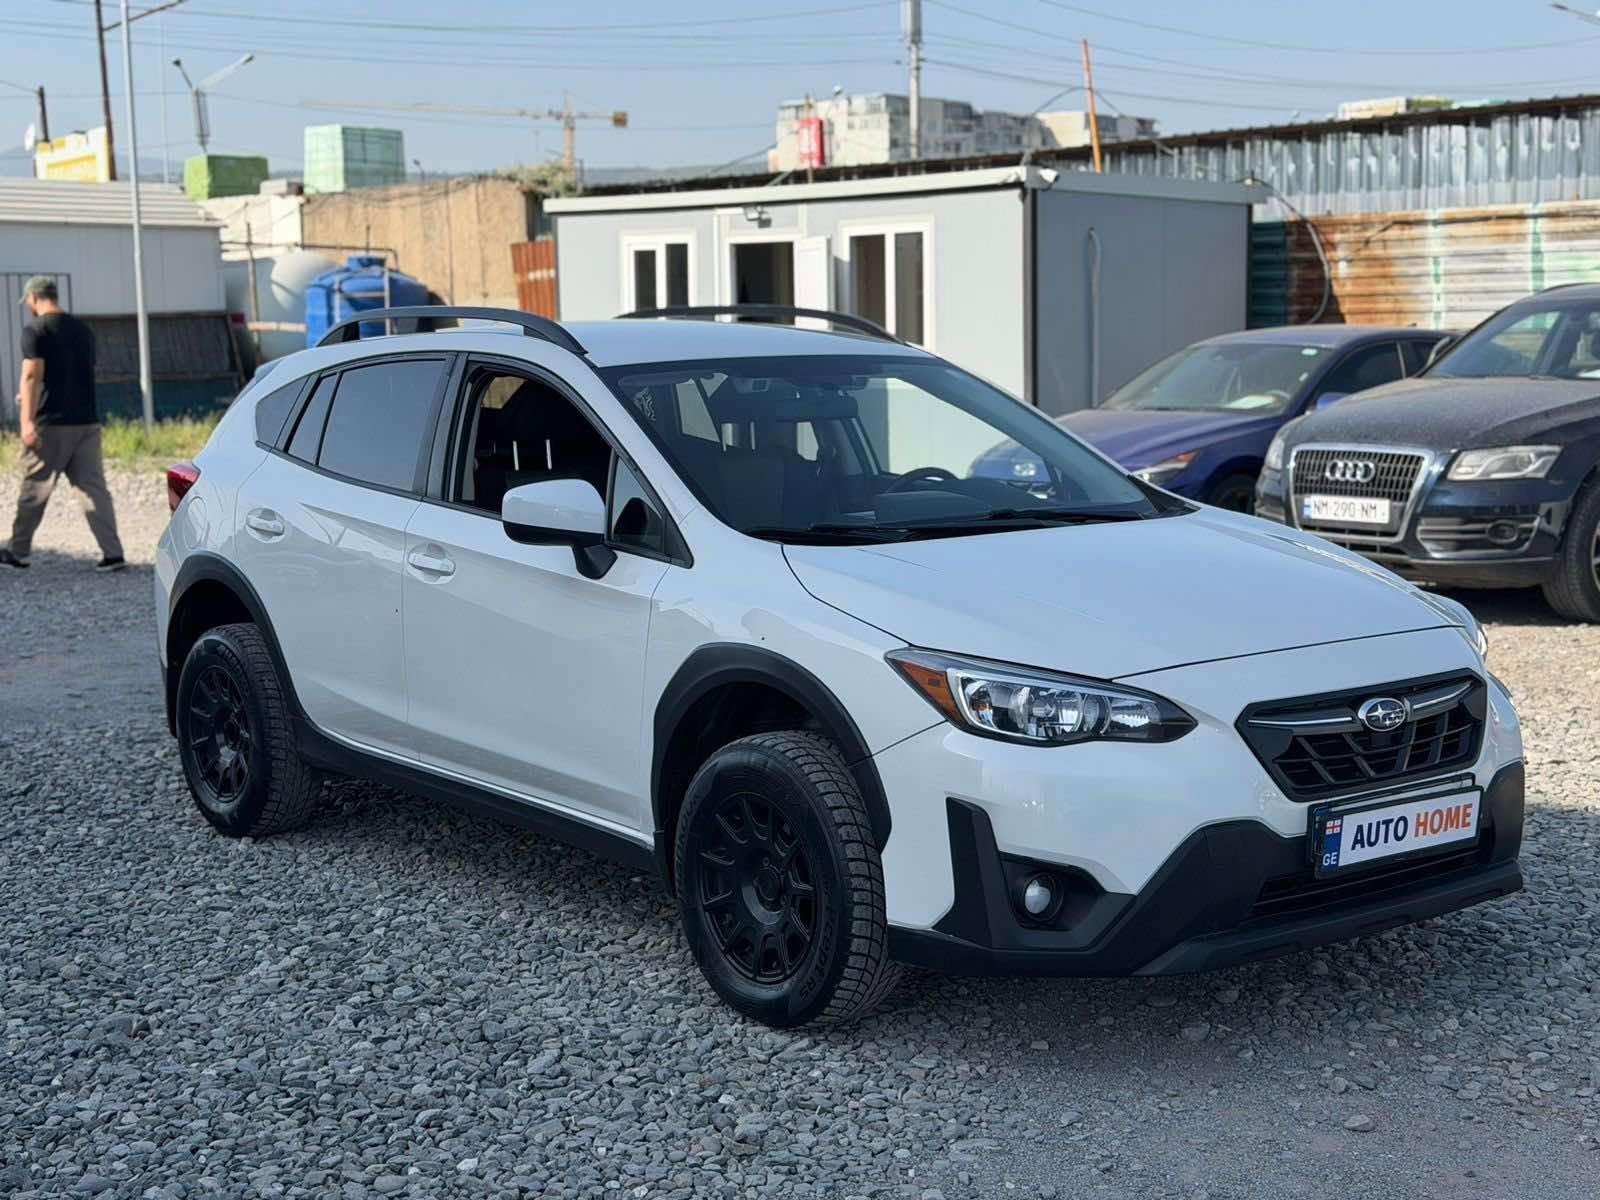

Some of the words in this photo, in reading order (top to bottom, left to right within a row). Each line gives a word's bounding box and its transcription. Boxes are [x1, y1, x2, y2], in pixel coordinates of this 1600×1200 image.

[1333, 502, 1355, 517] 290
[1351, 815, 1409, 851] AUTO
[1414, 803, 1473, 837] HOME
[1322, 852, 1338, 866] GE
